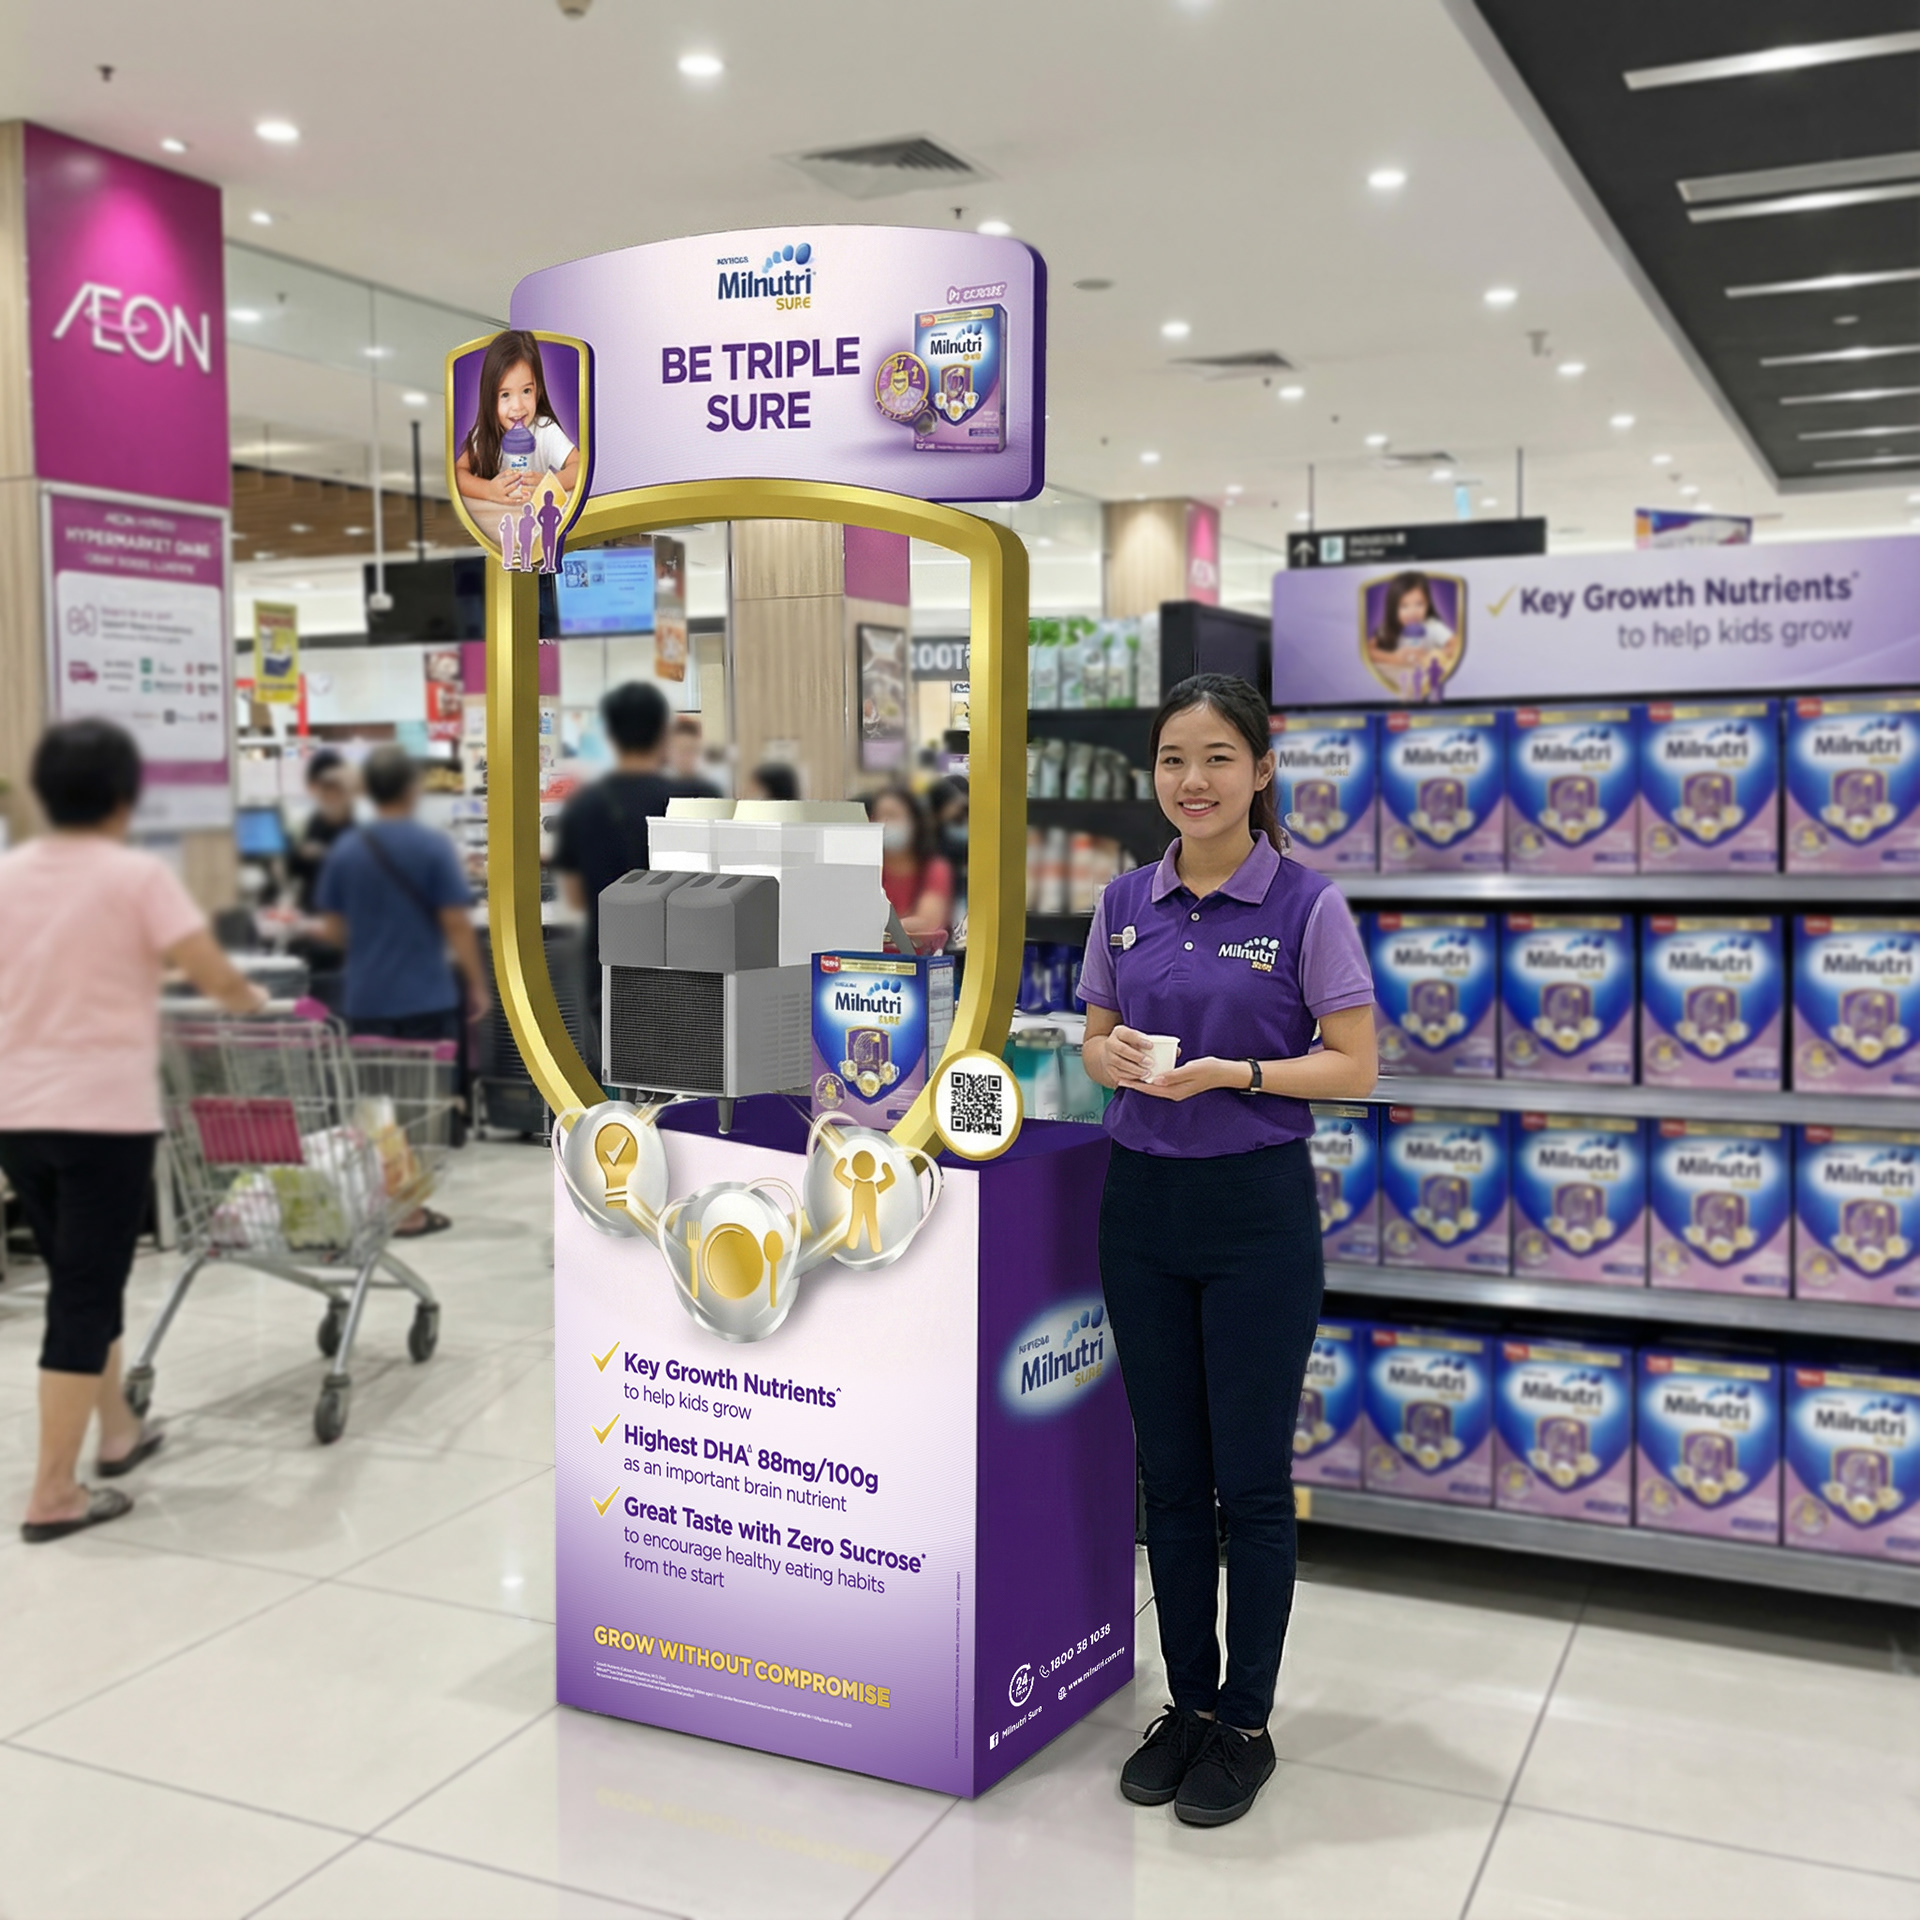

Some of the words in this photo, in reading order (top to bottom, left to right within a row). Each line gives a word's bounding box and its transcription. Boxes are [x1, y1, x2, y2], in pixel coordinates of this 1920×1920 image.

[718, 268, 811, 300] Milnutri
[776, 297, 811, 311] SURE
[662, 345, 712, 384] BE
[722, 337, 860, 380] TRIPLE
[930, 337, 982, 356] Milnutri
[706, 391, 811, 432] SURE
[1519, 586, 1575, 617] Key
[1584, 579, 1696, 611] Growth
[1618, 624, 1646, 649] to
[1653, 619, 1711, 650] help
[1718, 617, 1774, 645] kids
[1780, 619, 1853, 648] grow
[1218, 944, 1276, 965] Milnutri
[835, 992, 902, 1015] Milnutri
[625, 1352, 660, 1380] Key
[666, 1360, 737, 1390] Growth
[1021, 1331, 1103, 1395] Milnutri
[624, 1383, 639, 1399] to
[644, 1385, 674, 1408] help
[680, 1392, 708, 1412] kids
[713, 1402, 751, 1419] grow
[625, 1424, 697, 1456] Highest
[758, 1449, 878, 1495] 88mg/100g
[624, 1458, 639, 1472] as
[644, 1462, 661, 1476] an
[667, 1466, 739, 1491] important
[745, 1477, 781, 1499] brain
[787, 1489, 846, 1512] nutrient
[625, 1497, 677, 1525] Great
[682, 1507, 732, 1535] Taste
[738, 1521, 780, 1545] with
[787, 1528, 834, 1555] Zero
[624, 1527, 639, 1543] to
[644, 1534, 721, 1561] encourage
[727, 1546, 781, 1575] healthy
[786, 1563, 832, 1586] eating
[838, 1569, 884, 1593] habits
[624, 1552, 658, 1573] from
[663, 1561, 686, 1579] the
[691, 1568, 724, 1587] start
[594, 1625, 655, 1655] GROW
[659, 1639, 752, 1677] WITHOUT
[754, 1660, 891, 1708] COMPROMISE
[1050, 1648, 1074, 1672] 1800
[1076, 1638, 1088, 1654] 38
[1090, 1623, 1111, 1645] 1038
[1016, 1672, 1028, 1691] 24
[1002, 1715, 1027, 1739] Milnutri
